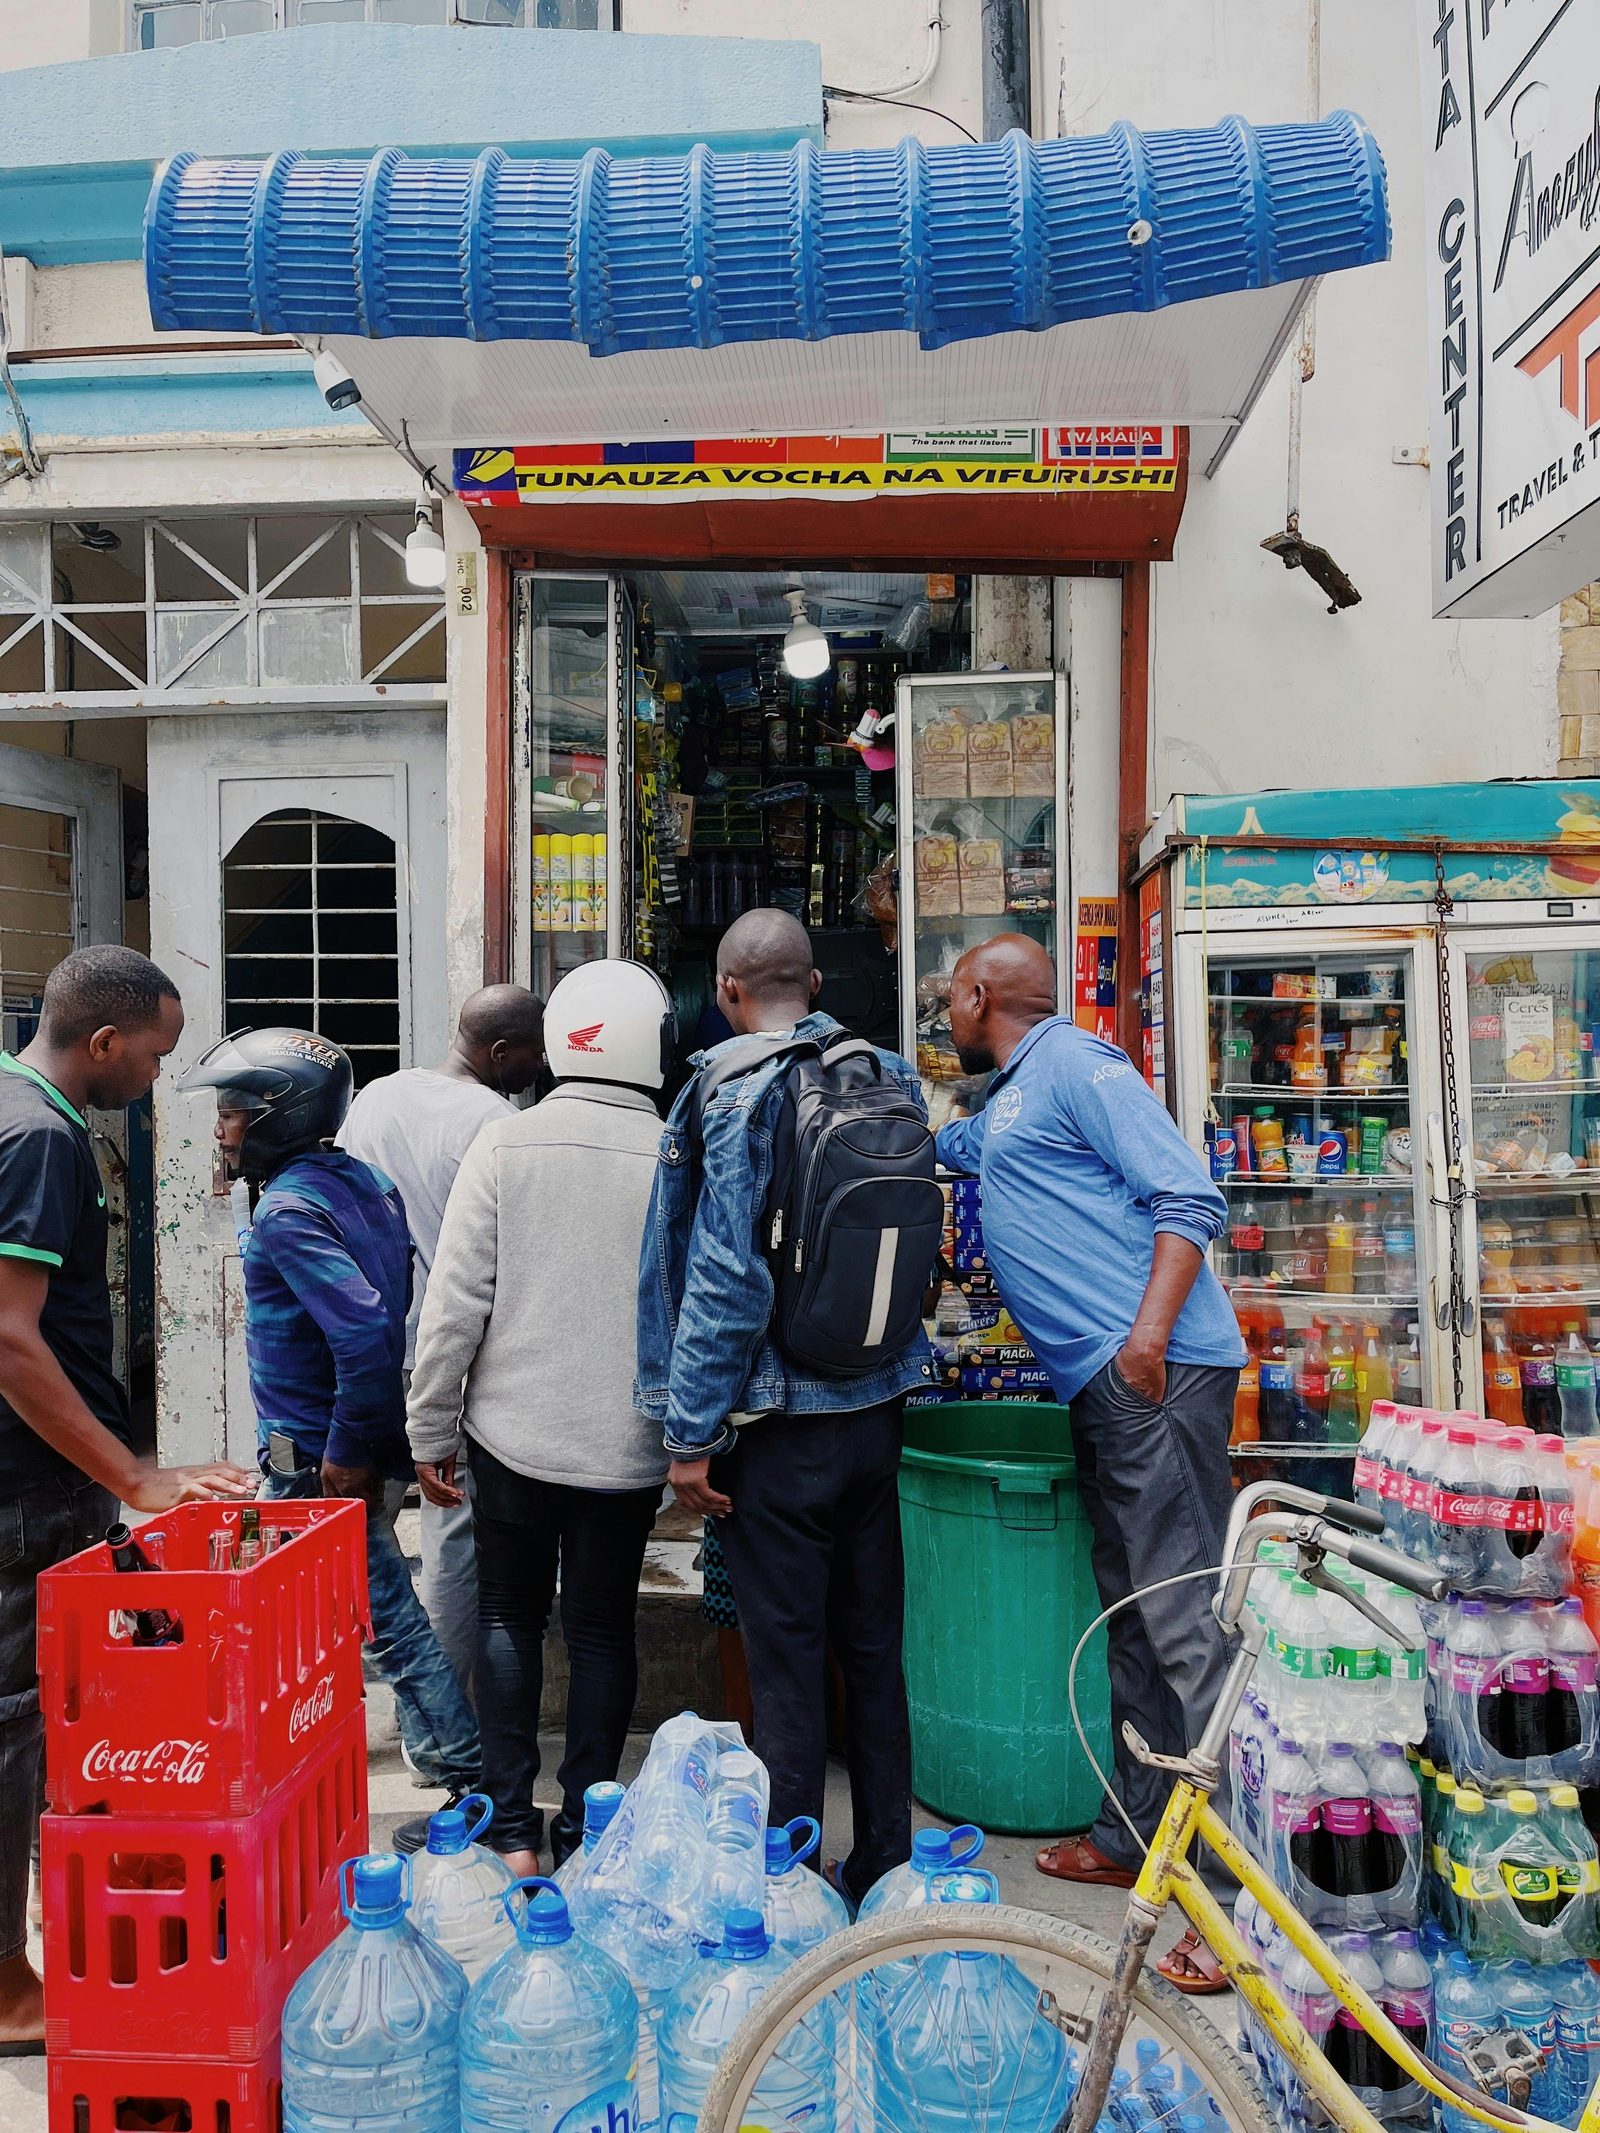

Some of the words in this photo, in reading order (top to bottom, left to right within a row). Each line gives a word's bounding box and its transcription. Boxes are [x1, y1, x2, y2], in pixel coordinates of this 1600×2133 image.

[1438, 198, 1467, 582] CENTER
[963, 438, 985, 446] that
[988, 438, 1013, 446] listens
[1066, 430, 1155, 443] WAKALA
[515, 471, 709, 488] TUNAUZA
[722, 468, 872, 486] VOCHA
[883, 469, 936, 484] NA
[955, 468, 1175, 485] VIFURUSHI
[1497, 457, 1568, 530] TRAVEL
[1573, 442, 1585, 474] &
[461, 587, 472, 611] 002
[1223, 855, 1278, 867] DELTA
[1508, 1002, 1549, 1014] Ceres
[269, 1034, 340, 1061] BOXER
[567, 1044, 605, 1053] HONDA
[268, 1049, 304, 1059] HAKUNA
[304, 1053, 334, 1070] MATATA
[1216, 1161, 1235, 1170] pepsi
[958, 1313, 998, 1331] Cheers
[1020, 1371, 1050, 1382] MAG
[290, 1671, 334, 1744] Coca-Cola
[82, 1739, 209, 1784] Coca-Cola
